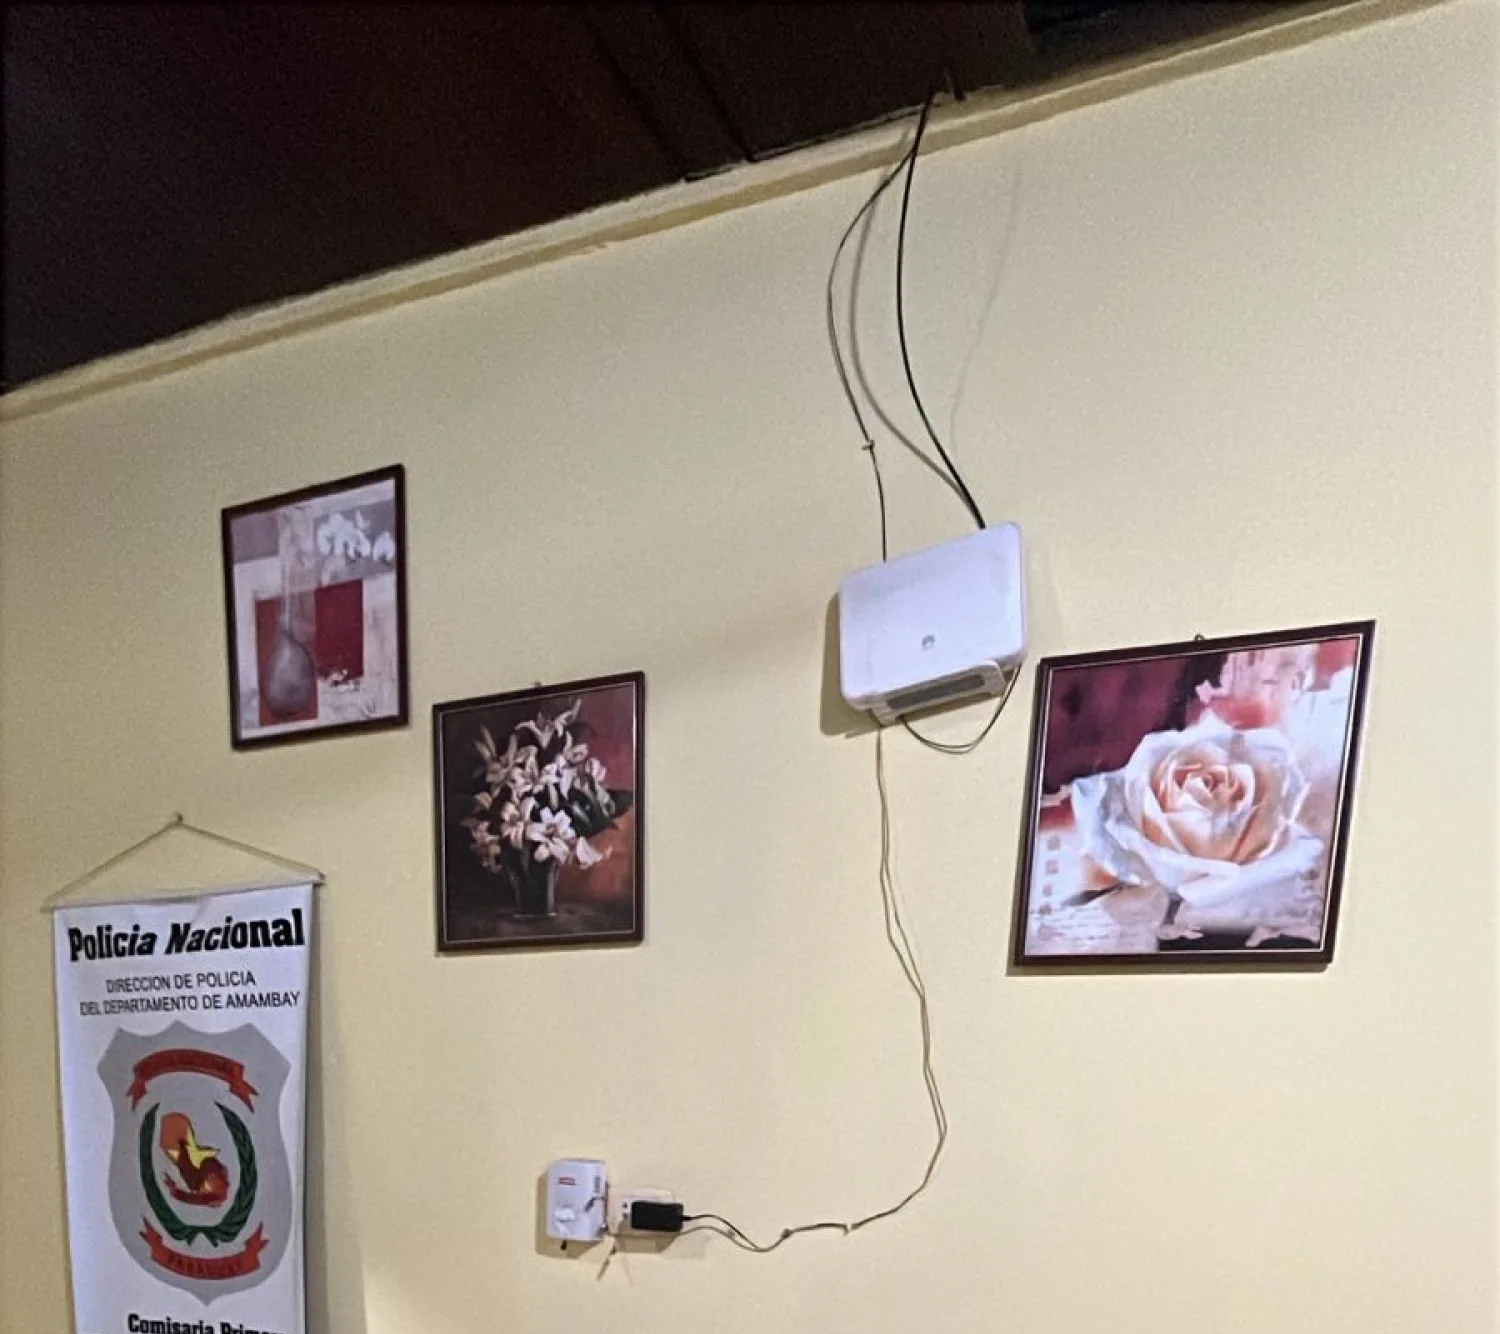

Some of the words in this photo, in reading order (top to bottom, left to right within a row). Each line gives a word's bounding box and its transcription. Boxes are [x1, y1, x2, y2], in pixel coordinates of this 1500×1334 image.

[68, 924, 157, 962] Policia
[165, 908, 305, 954] Nacional
[106, 975, 170, 993] DIRECCION
[174, 973, 192, 989] DE
[196, 971, 256, 988] POLICIA
[80, 1001, 101, 1015] DEL
[104, 996, 197, 1014] DEPARTAMENTO
[203, 995, 221, 1009] DE
[226, 992, 300, 1009] AMAMBAY
